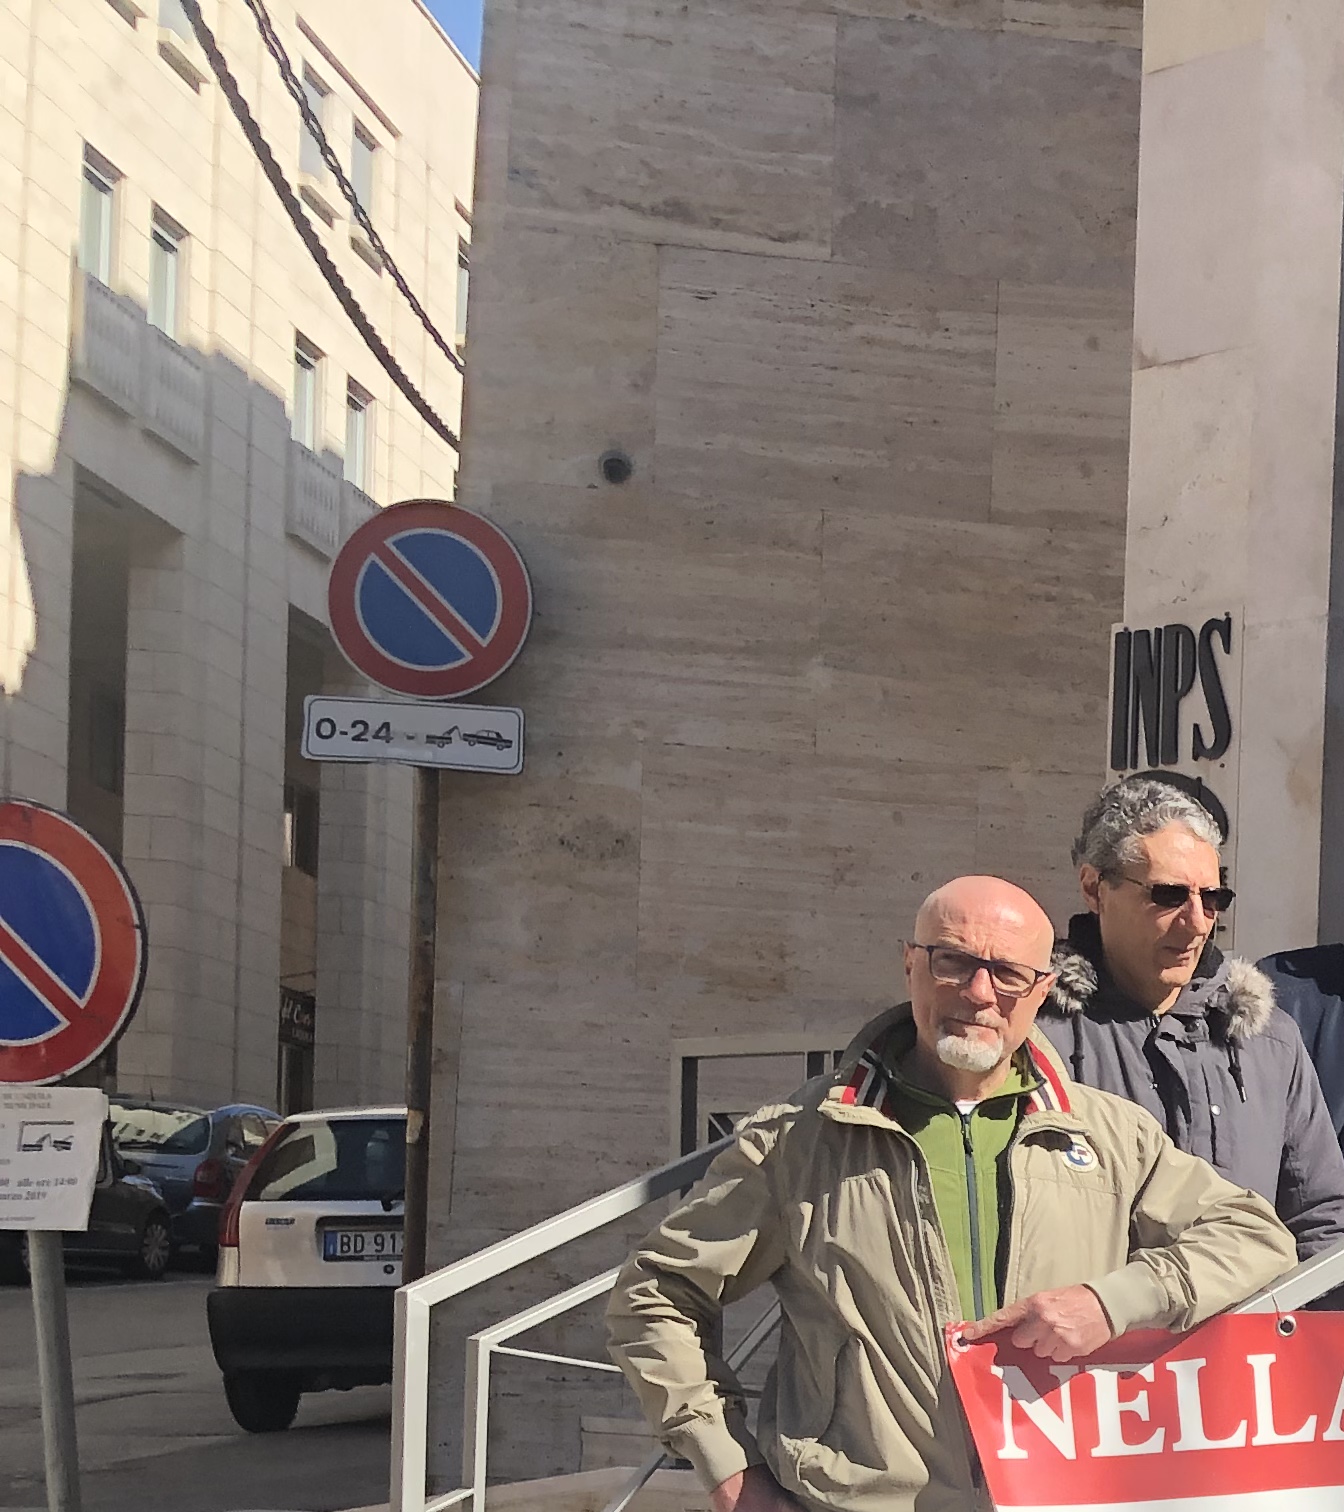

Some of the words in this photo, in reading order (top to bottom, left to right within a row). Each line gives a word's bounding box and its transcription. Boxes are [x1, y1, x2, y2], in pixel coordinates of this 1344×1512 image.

[1111, 617, 1232, 771] INPS
[315, 718, 394, 743] 0-24
[340, 1233, 365, 1254] BD
[374, 1233, 403, 1254] 91
